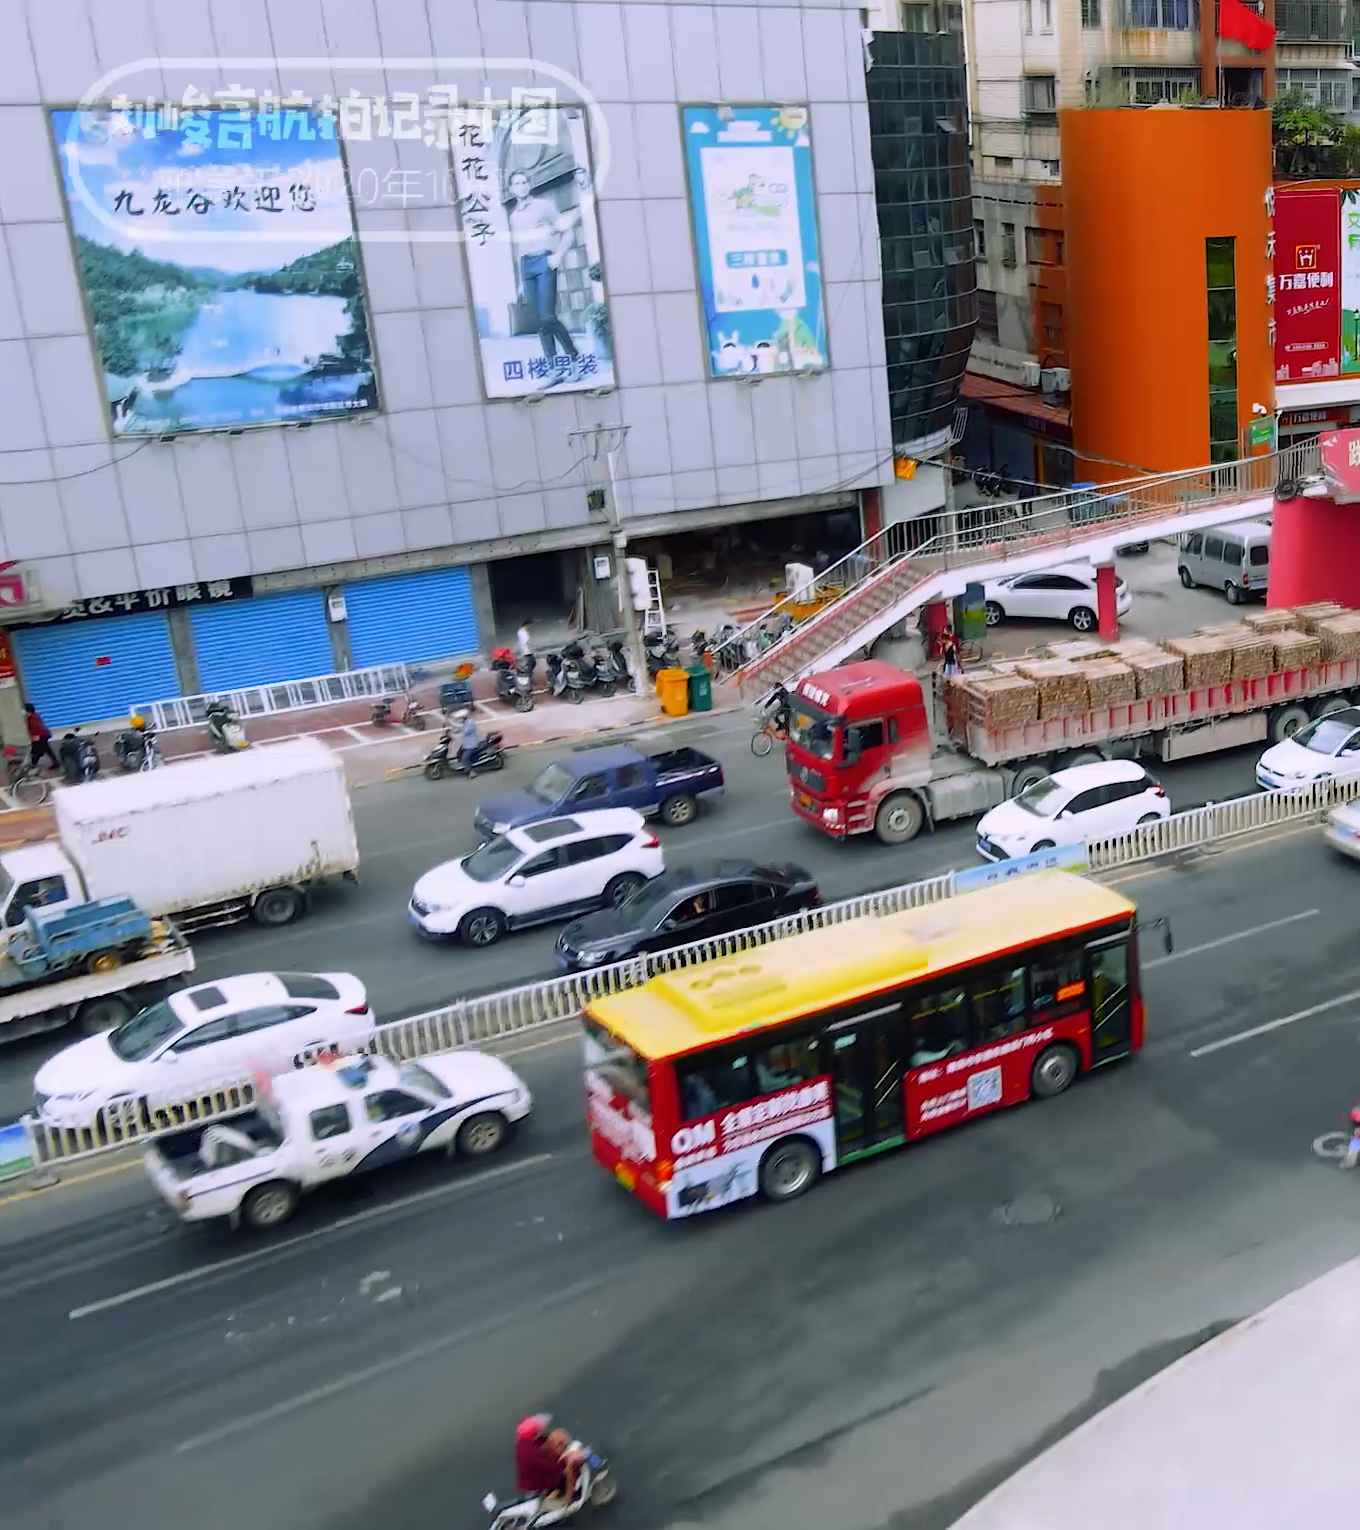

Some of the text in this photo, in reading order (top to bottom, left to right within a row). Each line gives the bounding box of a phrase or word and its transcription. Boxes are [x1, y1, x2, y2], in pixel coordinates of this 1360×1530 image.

[113, 184, 318, 216] 九龙谷欢迎您
[458, 124, 496, 246] 花花公子
[503, 354, 600, 382] 四楼男装
